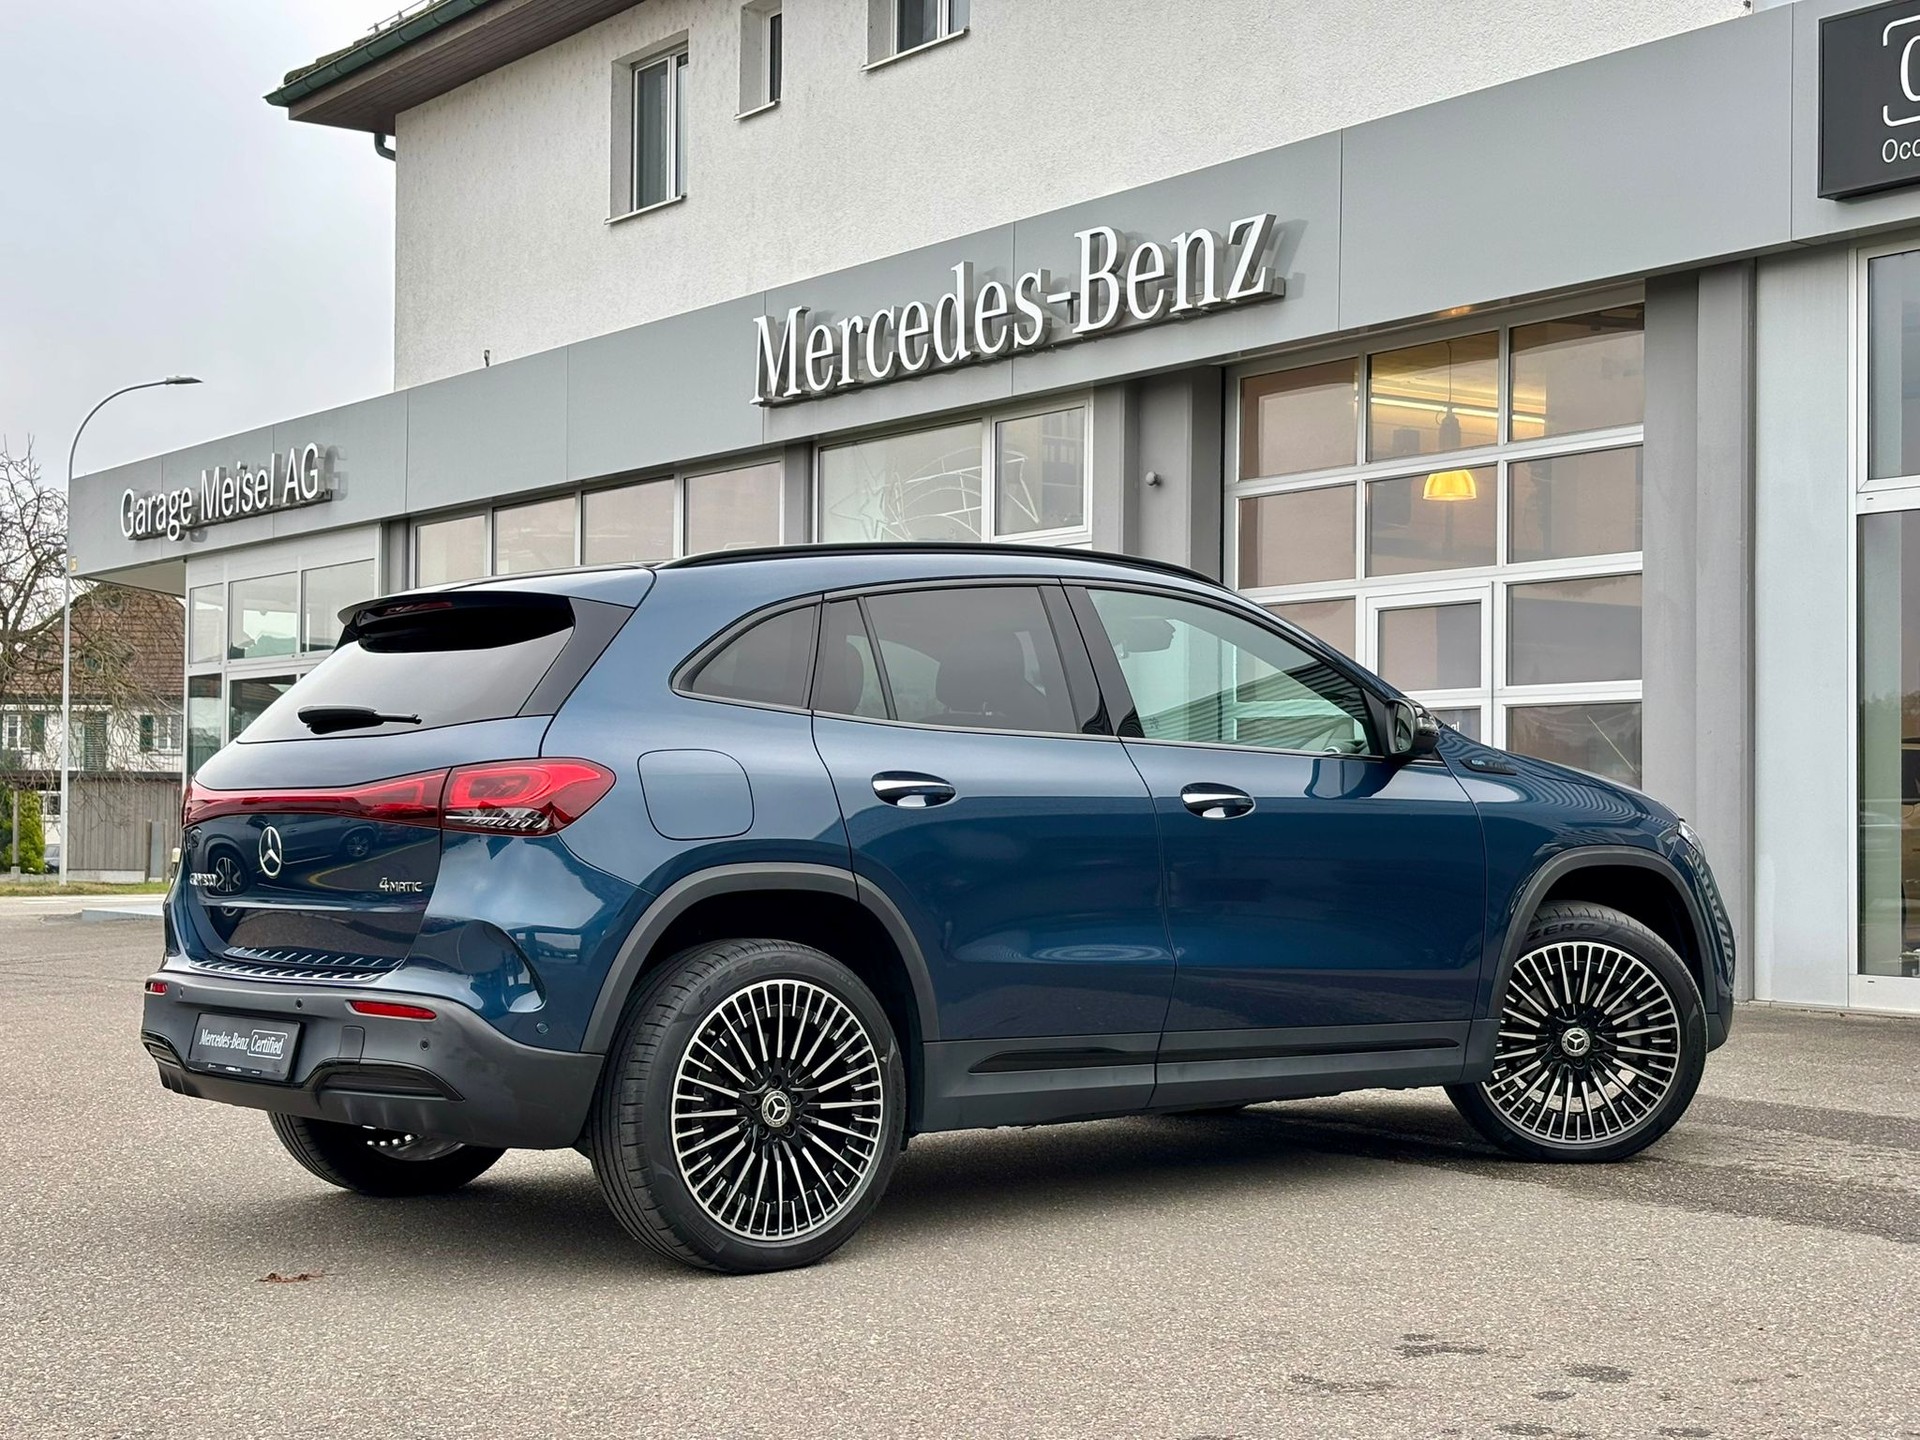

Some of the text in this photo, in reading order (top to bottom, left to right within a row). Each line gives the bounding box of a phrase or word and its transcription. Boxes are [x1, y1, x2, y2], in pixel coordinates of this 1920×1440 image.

[750, 213, 1279, 405] Mercedes-Benz
[120, 442, 319, 541] Garage Meisel AG
[379, 877, 423, 892] 4MATIC
[199, 1028, 285, 1055] Mercedes-Benz Certified
